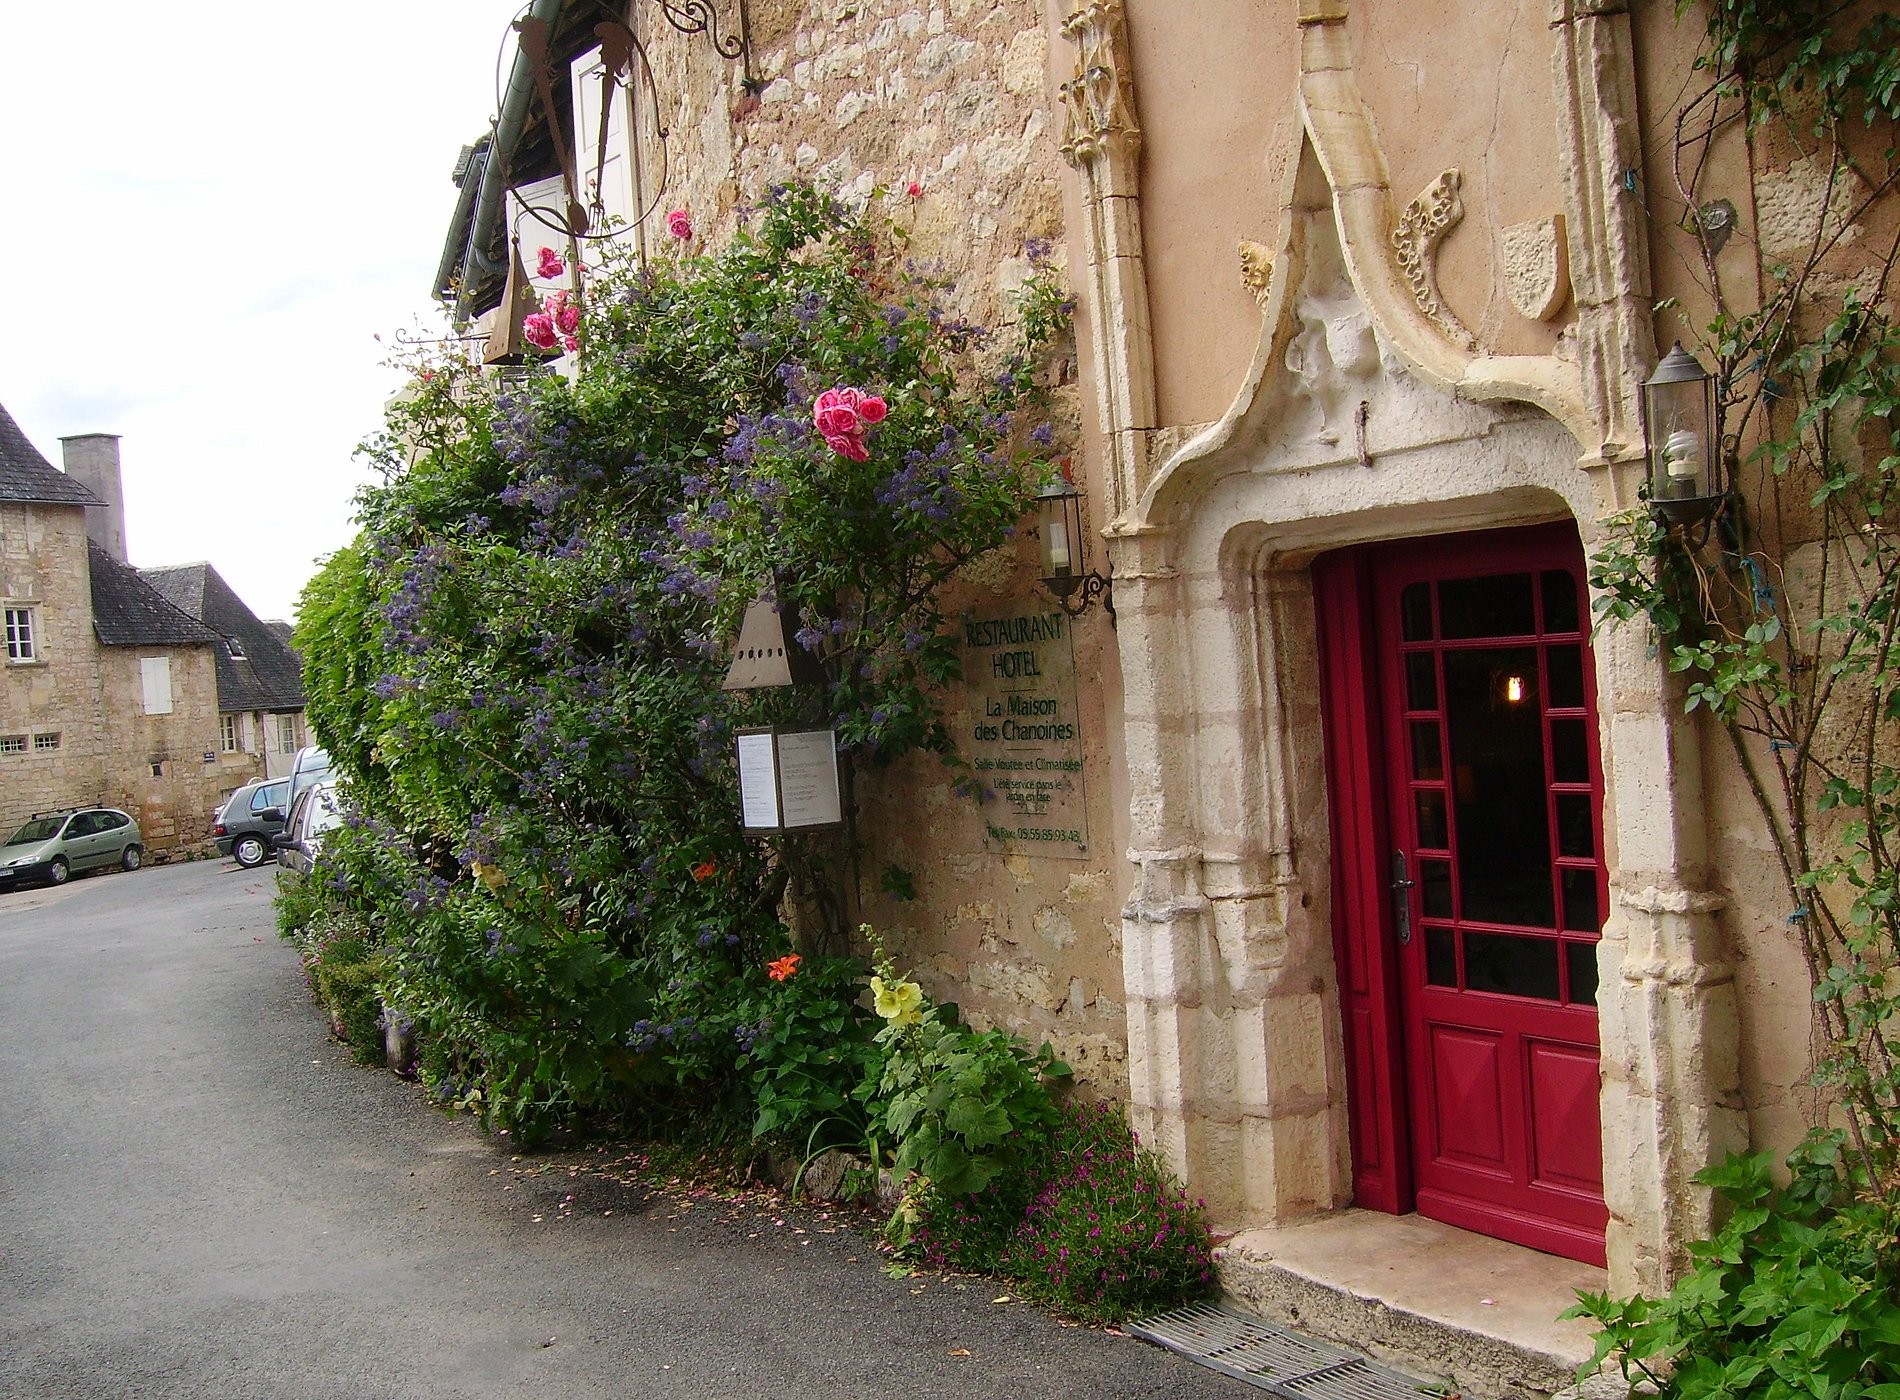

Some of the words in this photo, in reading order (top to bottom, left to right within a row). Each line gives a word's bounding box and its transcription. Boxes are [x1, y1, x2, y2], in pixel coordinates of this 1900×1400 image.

[965, 613, 1061, 648] RESTAURANT
[991, 651, 1041, 678] HOTEL
[986, 696, 1001, 716] La
[1007, 695, 1056, 716] Maison
[975, 720, 997, 741] des
[1002, 719, 1073, 741] Chanoines
[974, 757, 993, 770] Salle
[1025, 760, 1034, 770] et
[1035, 757, 1081, 771] Climatisée
[1011, 779, 1034, 789] service
[1036, 778, 1053, 789] dans
[1055, 779, 1062, 789] le
[1006, 791, 1024, 802] jardin
[1025, 793, 1035, 801] en
[1036, 790, 1051, 802] face
